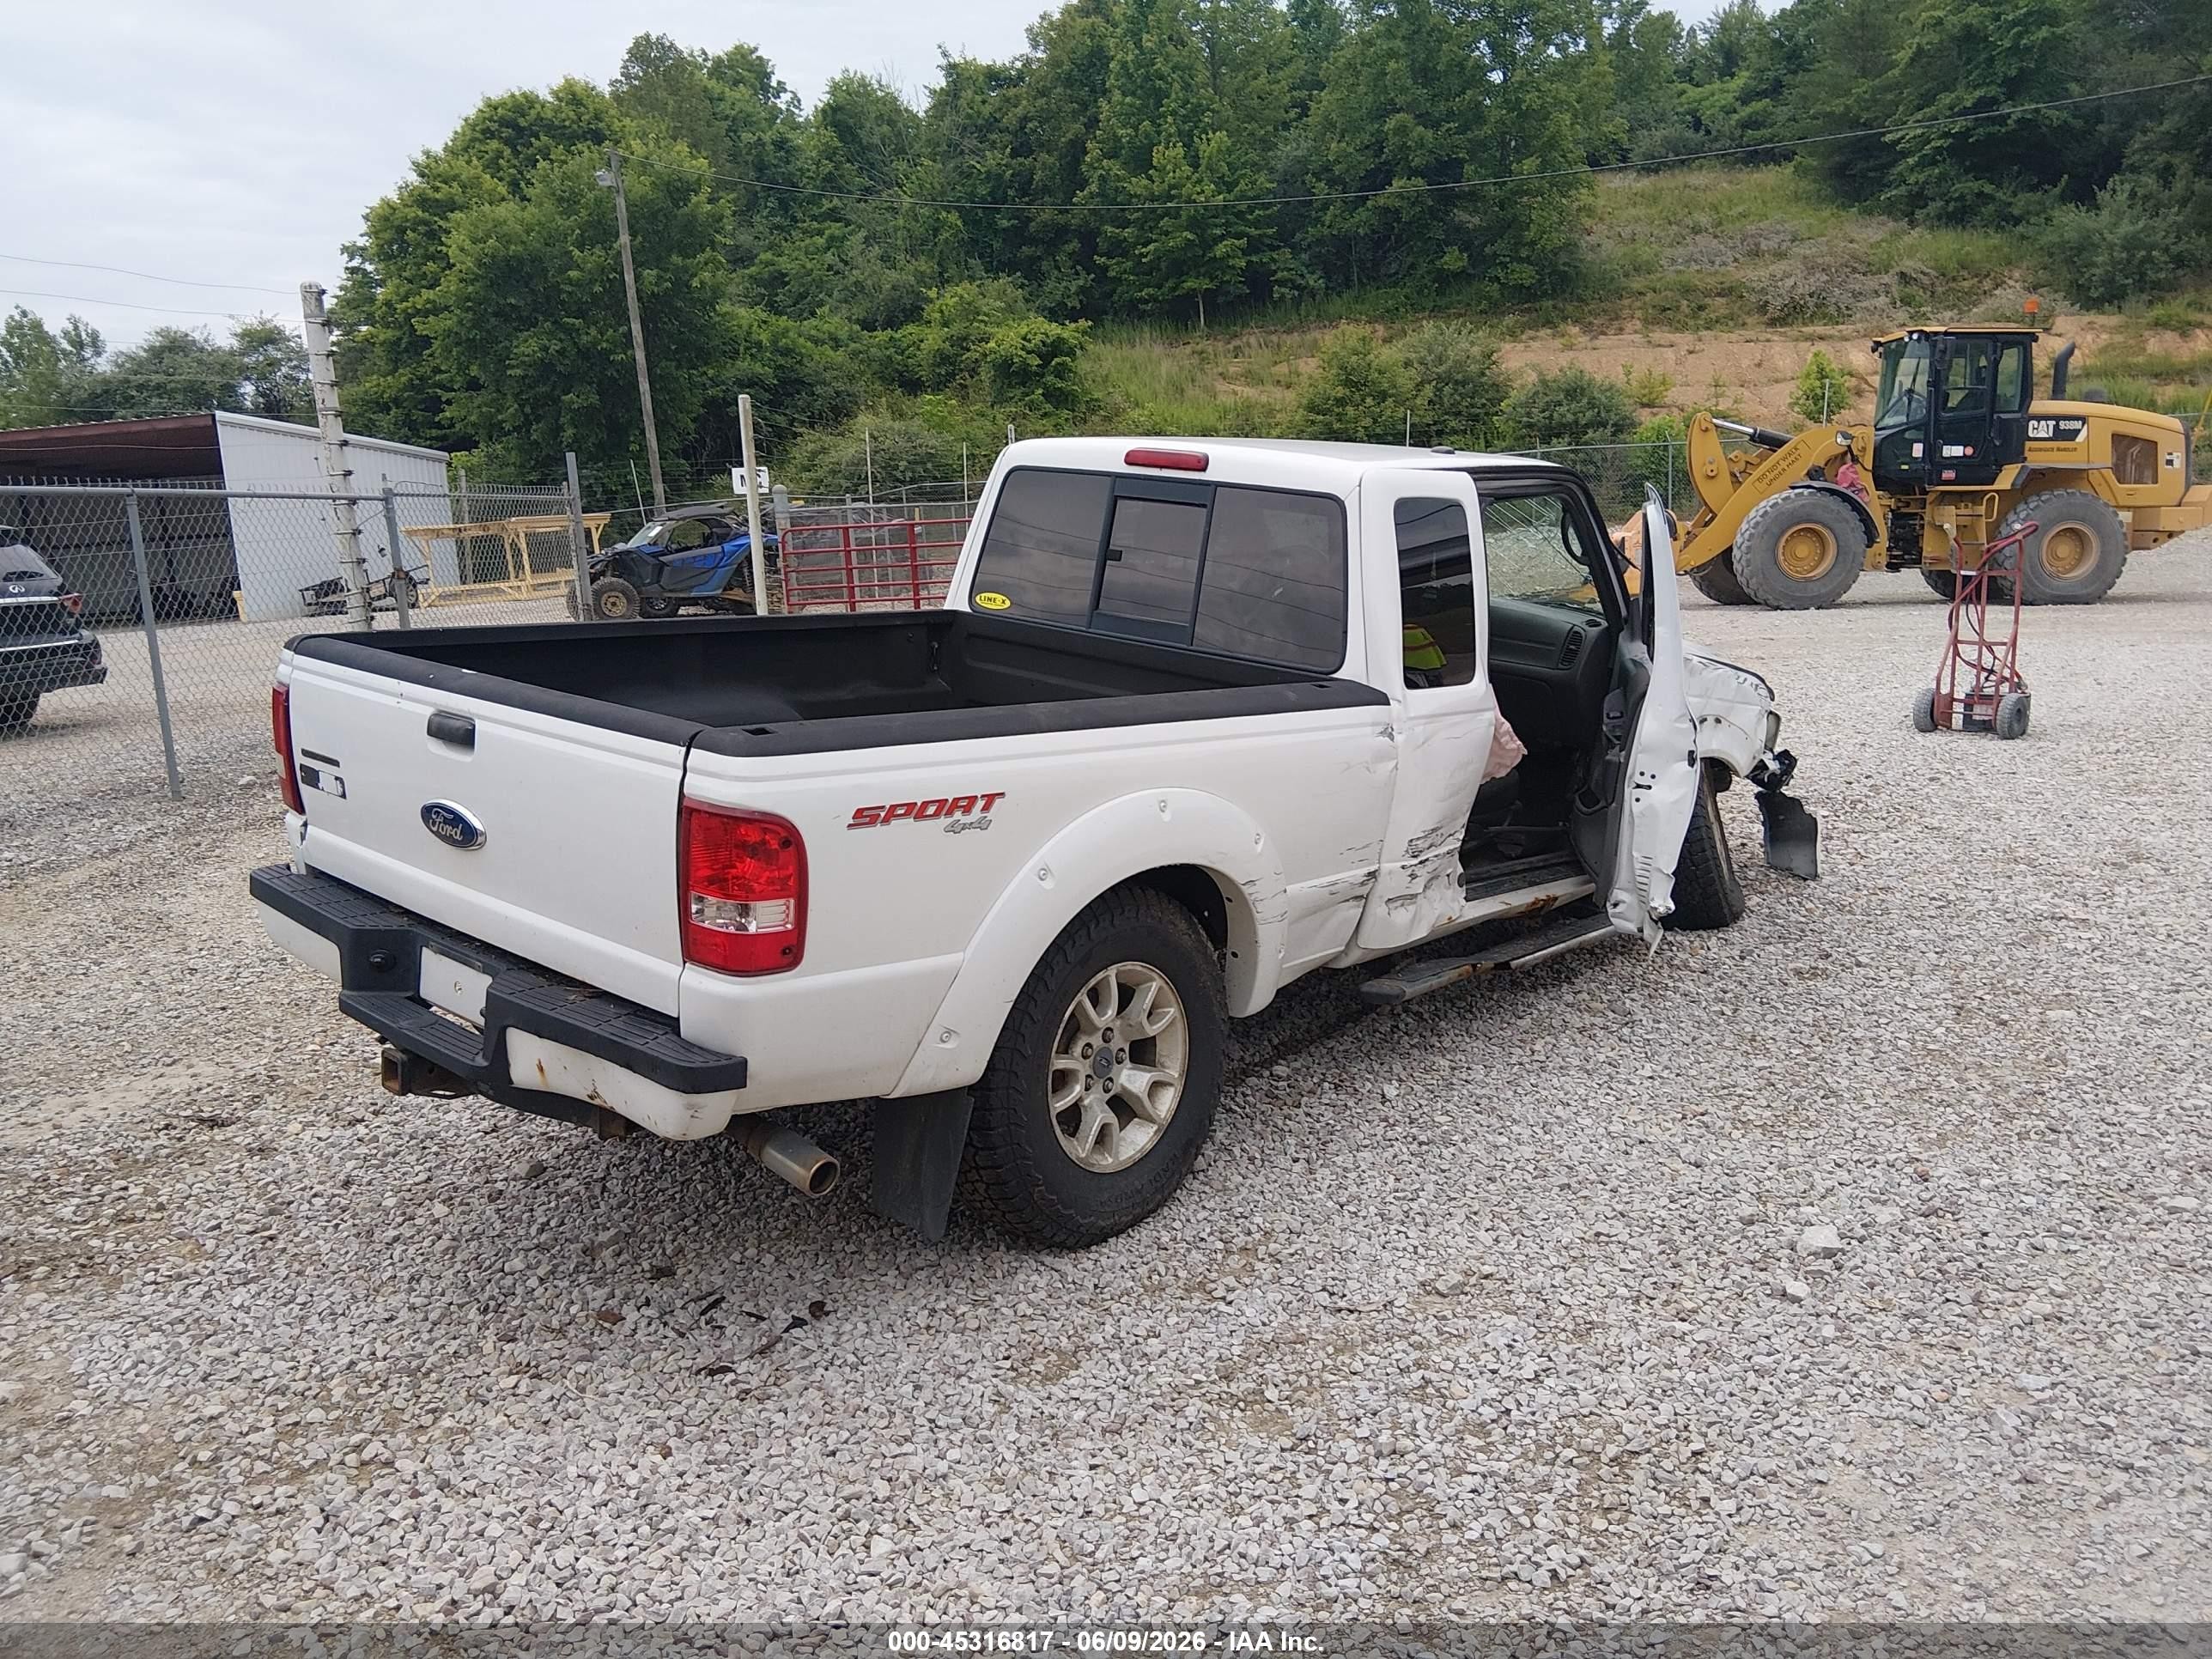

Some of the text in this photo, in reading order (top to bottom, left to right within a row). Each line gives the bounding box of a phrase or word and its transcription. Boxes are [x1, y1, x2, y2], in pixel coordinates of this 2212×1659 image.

[2027, 420, 2057, 438] CAT
[1765, 453, 1802, 487] UNDER MAST
[979, 595, 1006, 605] LINE-X
[846, 792, 1006, 830] SPORT
[429, 808, 464, 842] Ford
[944, 816, 993, 834] 4x4
